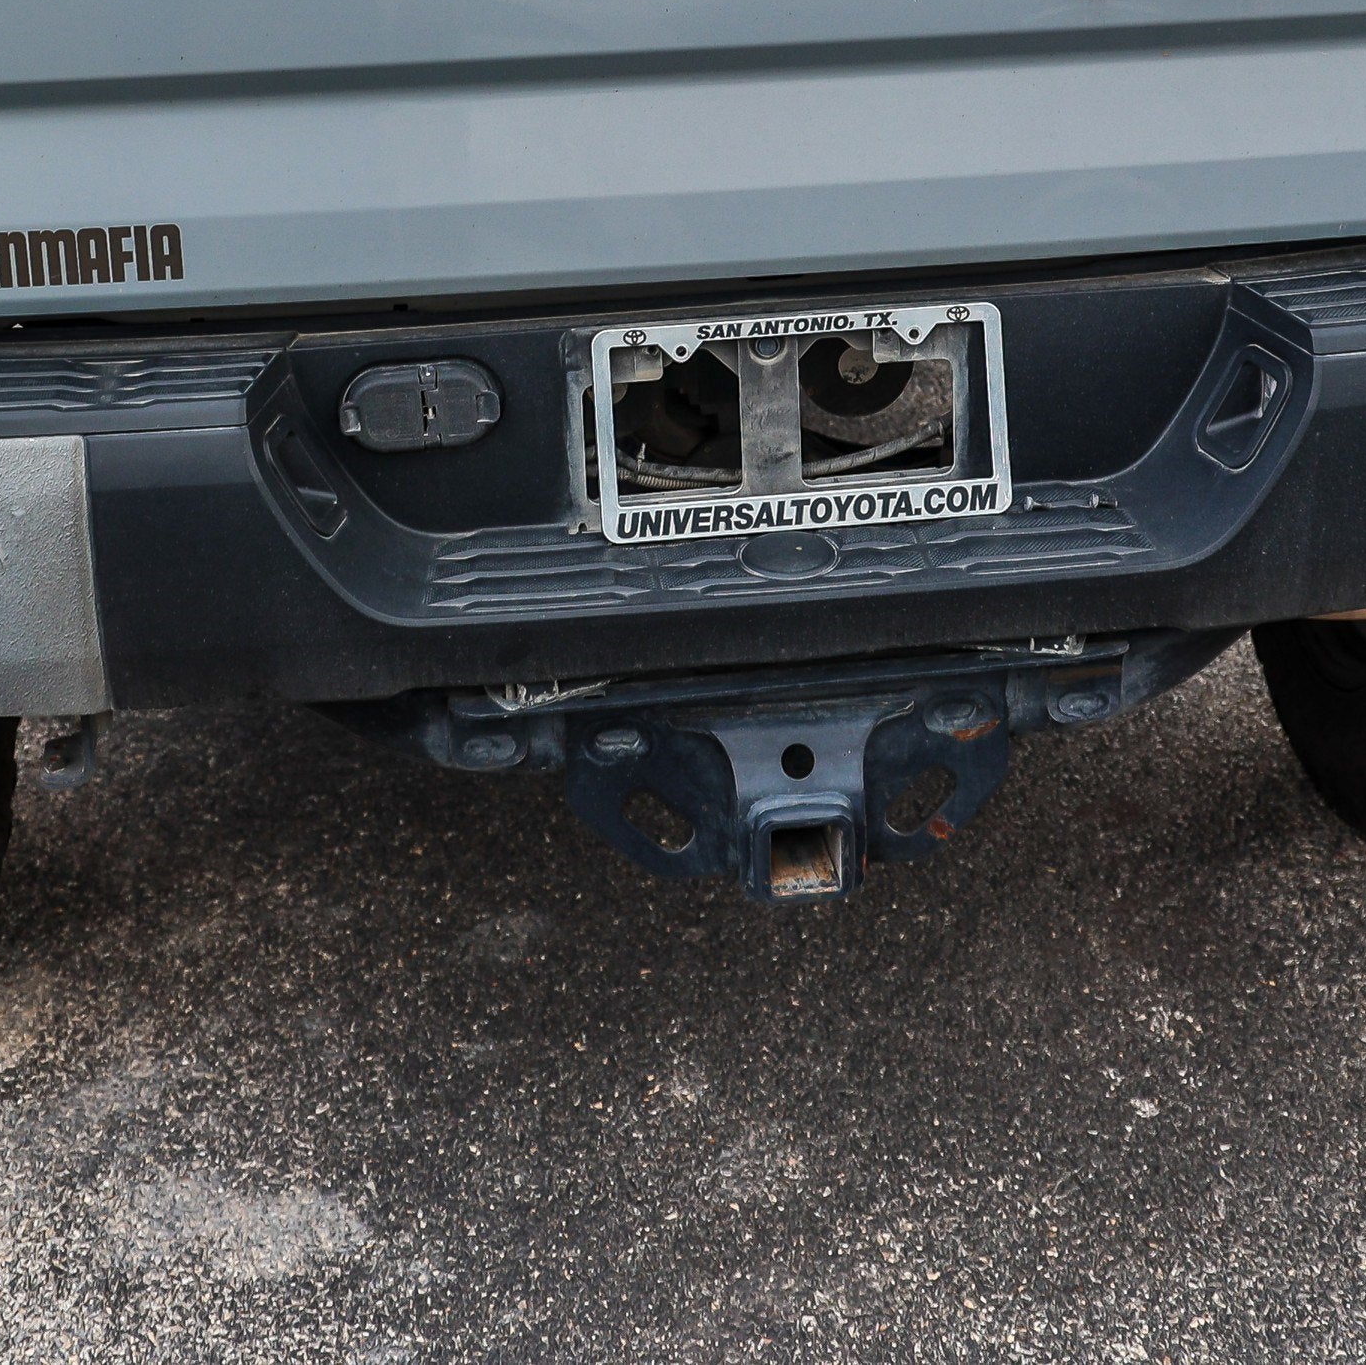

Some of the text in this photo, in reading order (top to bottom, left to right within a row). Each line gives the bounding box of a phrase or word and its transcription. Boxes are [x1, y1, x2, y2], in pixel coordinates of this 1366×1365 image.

[696, 312, 898, 340] SAN ANTONIO, TX.
[617, 482, 999, 540] UNIVERSALTOYOTA.COM
